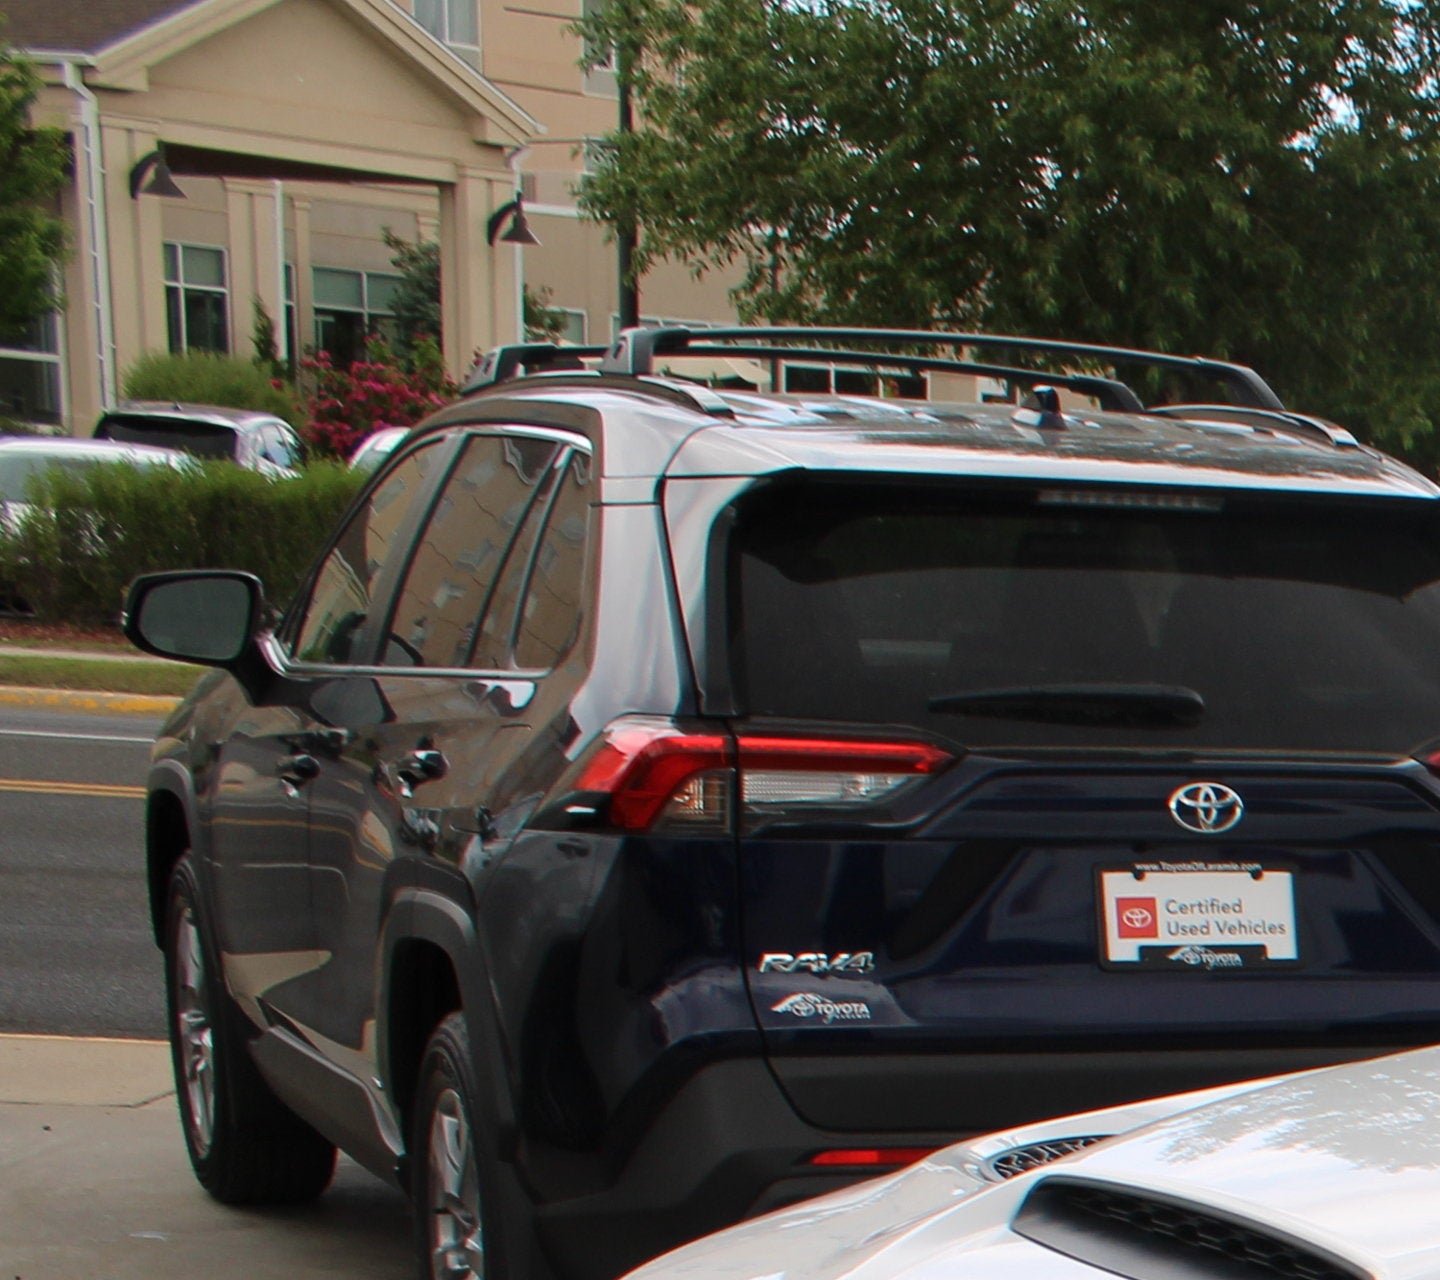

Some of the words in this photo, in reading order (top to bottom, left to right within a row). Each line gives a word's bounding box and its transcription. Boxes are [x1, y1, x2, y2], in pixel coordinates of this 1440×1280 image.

[1165, 898, 1244, 915] Certified
[1166, 920, 1211, 936] Used
[1214, 920, 1287, 936] Vehicles
[758, 952, 876, 974] RAV4
[814, 1002, 871, 1015] TOYOTA
